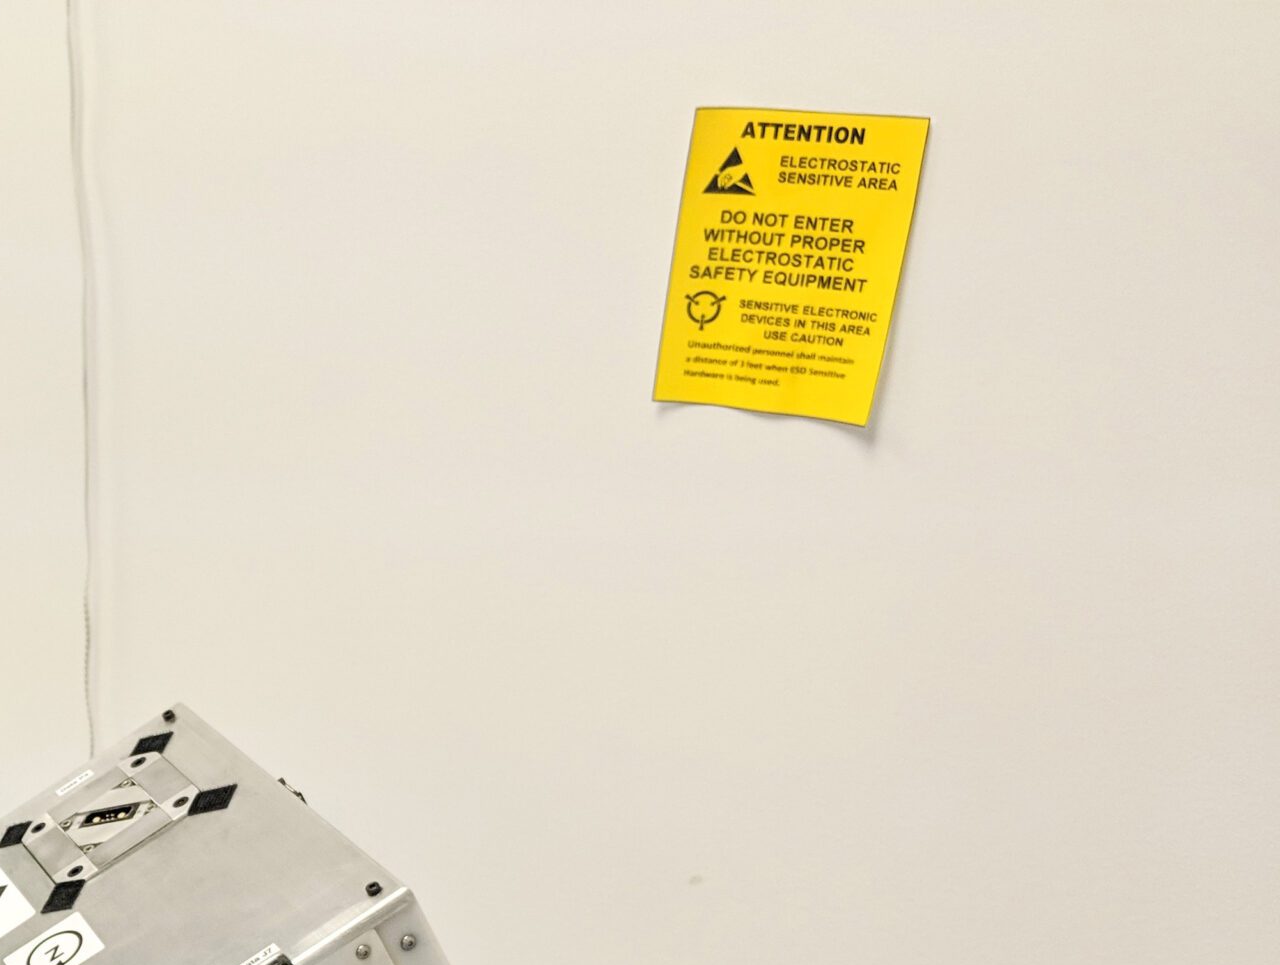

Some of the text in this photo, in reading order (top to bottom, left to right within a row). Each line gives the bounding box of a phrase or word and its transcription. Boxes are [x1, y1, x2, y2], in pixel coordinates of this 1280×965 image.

[741, 122, 866, 144] ATTENTION
[780, 156, 901, 174] ELECTROSTATIC
[778, 172, 898, 191] SENSITIVE AREA
[720, 210, 854, 234] DO NOT ENTER
[704, 228, 866, 254] WITHOUT PROPER
[707, 247, 855, 272] ELECTROSTATIC
[689, 265, 868, 293] SAFETY EQUIPMENT
[739, 299, 878, 322] SENSITIVE ELECTRONIC
[740, 313, 871, 336] DEVICES IN THIS AREA
[763, 330, 844, 346] USE CAUTION
[688, 340, 855, 365] Unauthorized personnel shall maintain
[684, 368, 725, 380] Hardware
[726, 373, 732, 381] is
[734, 374, 756, 385] being
[693, 354, 728, 366] distance
[729, 358, 738, 367] of
[746, 361, 763, 370] feet
[764, 362, 788, 374] when
[790, 364, 807, 375] ESD
[808, 367, 846, 380] Sensitive
[44, 945, 64, 962] Z
